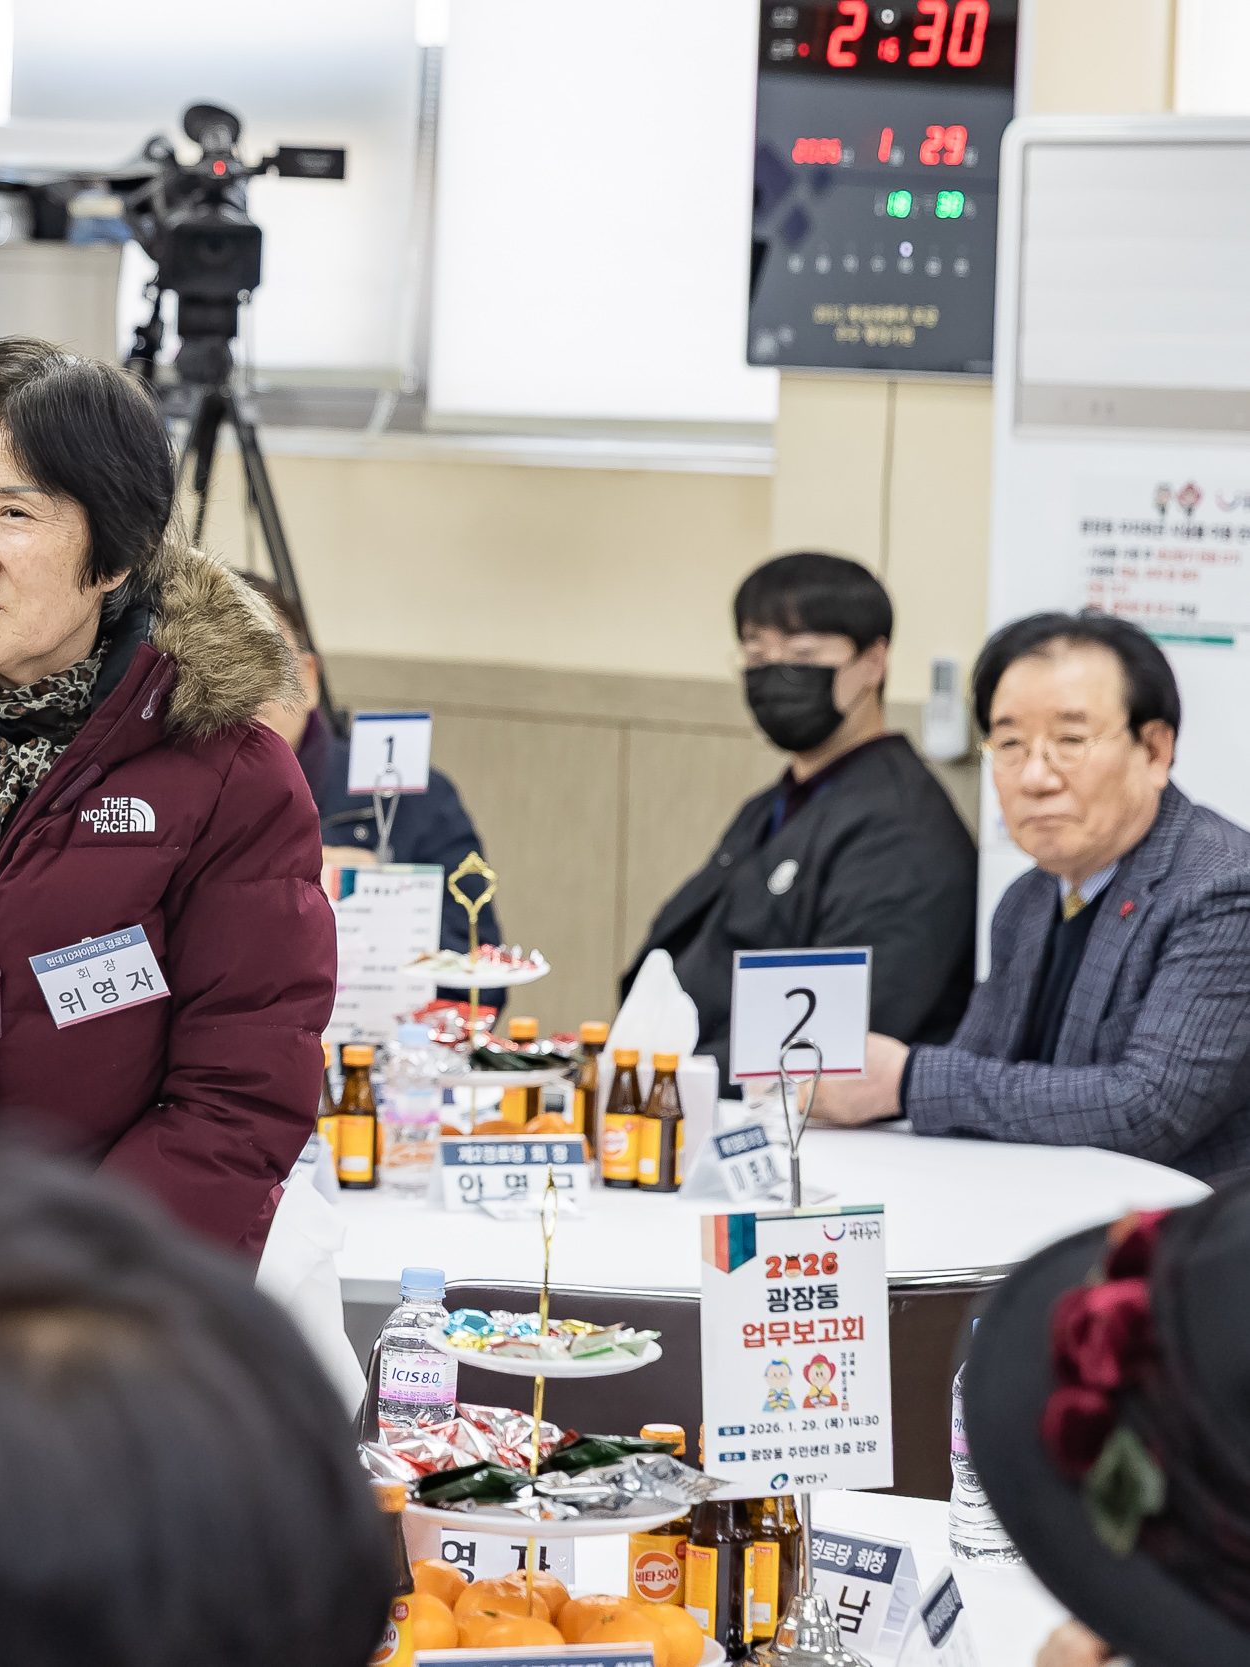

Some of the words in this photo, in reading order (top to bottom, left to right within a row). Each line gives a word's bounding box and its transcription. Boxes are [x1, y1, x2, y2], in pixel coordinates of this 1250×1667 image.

[908, 0, 990, 67] 30
[80, 809, 129, 822] NORTH
[102, 797, 129, 809] THE
[93, 821, 129, 833] FACE
[780, 987, 817, 1050] 2
[766, 1284, 840, 1313] 광장동
[742, 1315, 865, 1348] 업무보고회
[849, 1415, 879, 1427] 14:30
[812, 1538, 852, 1567] 경로당
[855, 1547, 887, 1574] 회장
